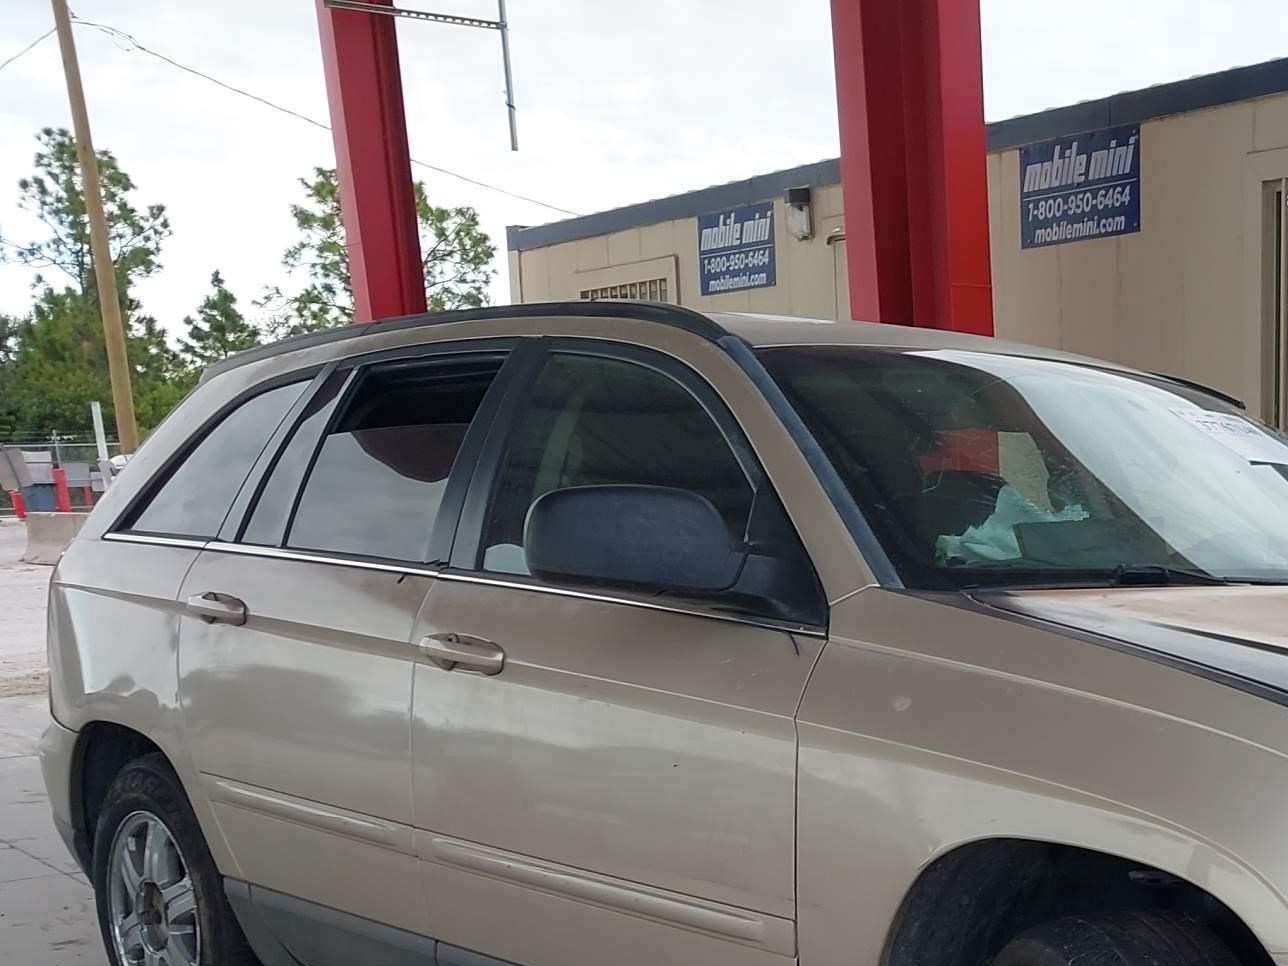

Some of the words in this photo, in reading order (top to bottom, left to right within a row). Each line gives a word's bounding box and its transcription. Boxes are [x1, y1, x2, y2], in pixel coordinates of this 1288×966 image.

[1023, 141, 1087, 193] mobile
[1088, 135, 1138, 180] mini
[1028, 185, 1131, 222] 1-800-950-6464
[701, 212, 741, 251] mobile
[742, 211, 772, 244] mini
[1034, 215, 1126, 244] mobilemini.com
[704, 248, 769, 274] 1-800-950-6464
[708, 272, 767, 292] mobilemini.com
